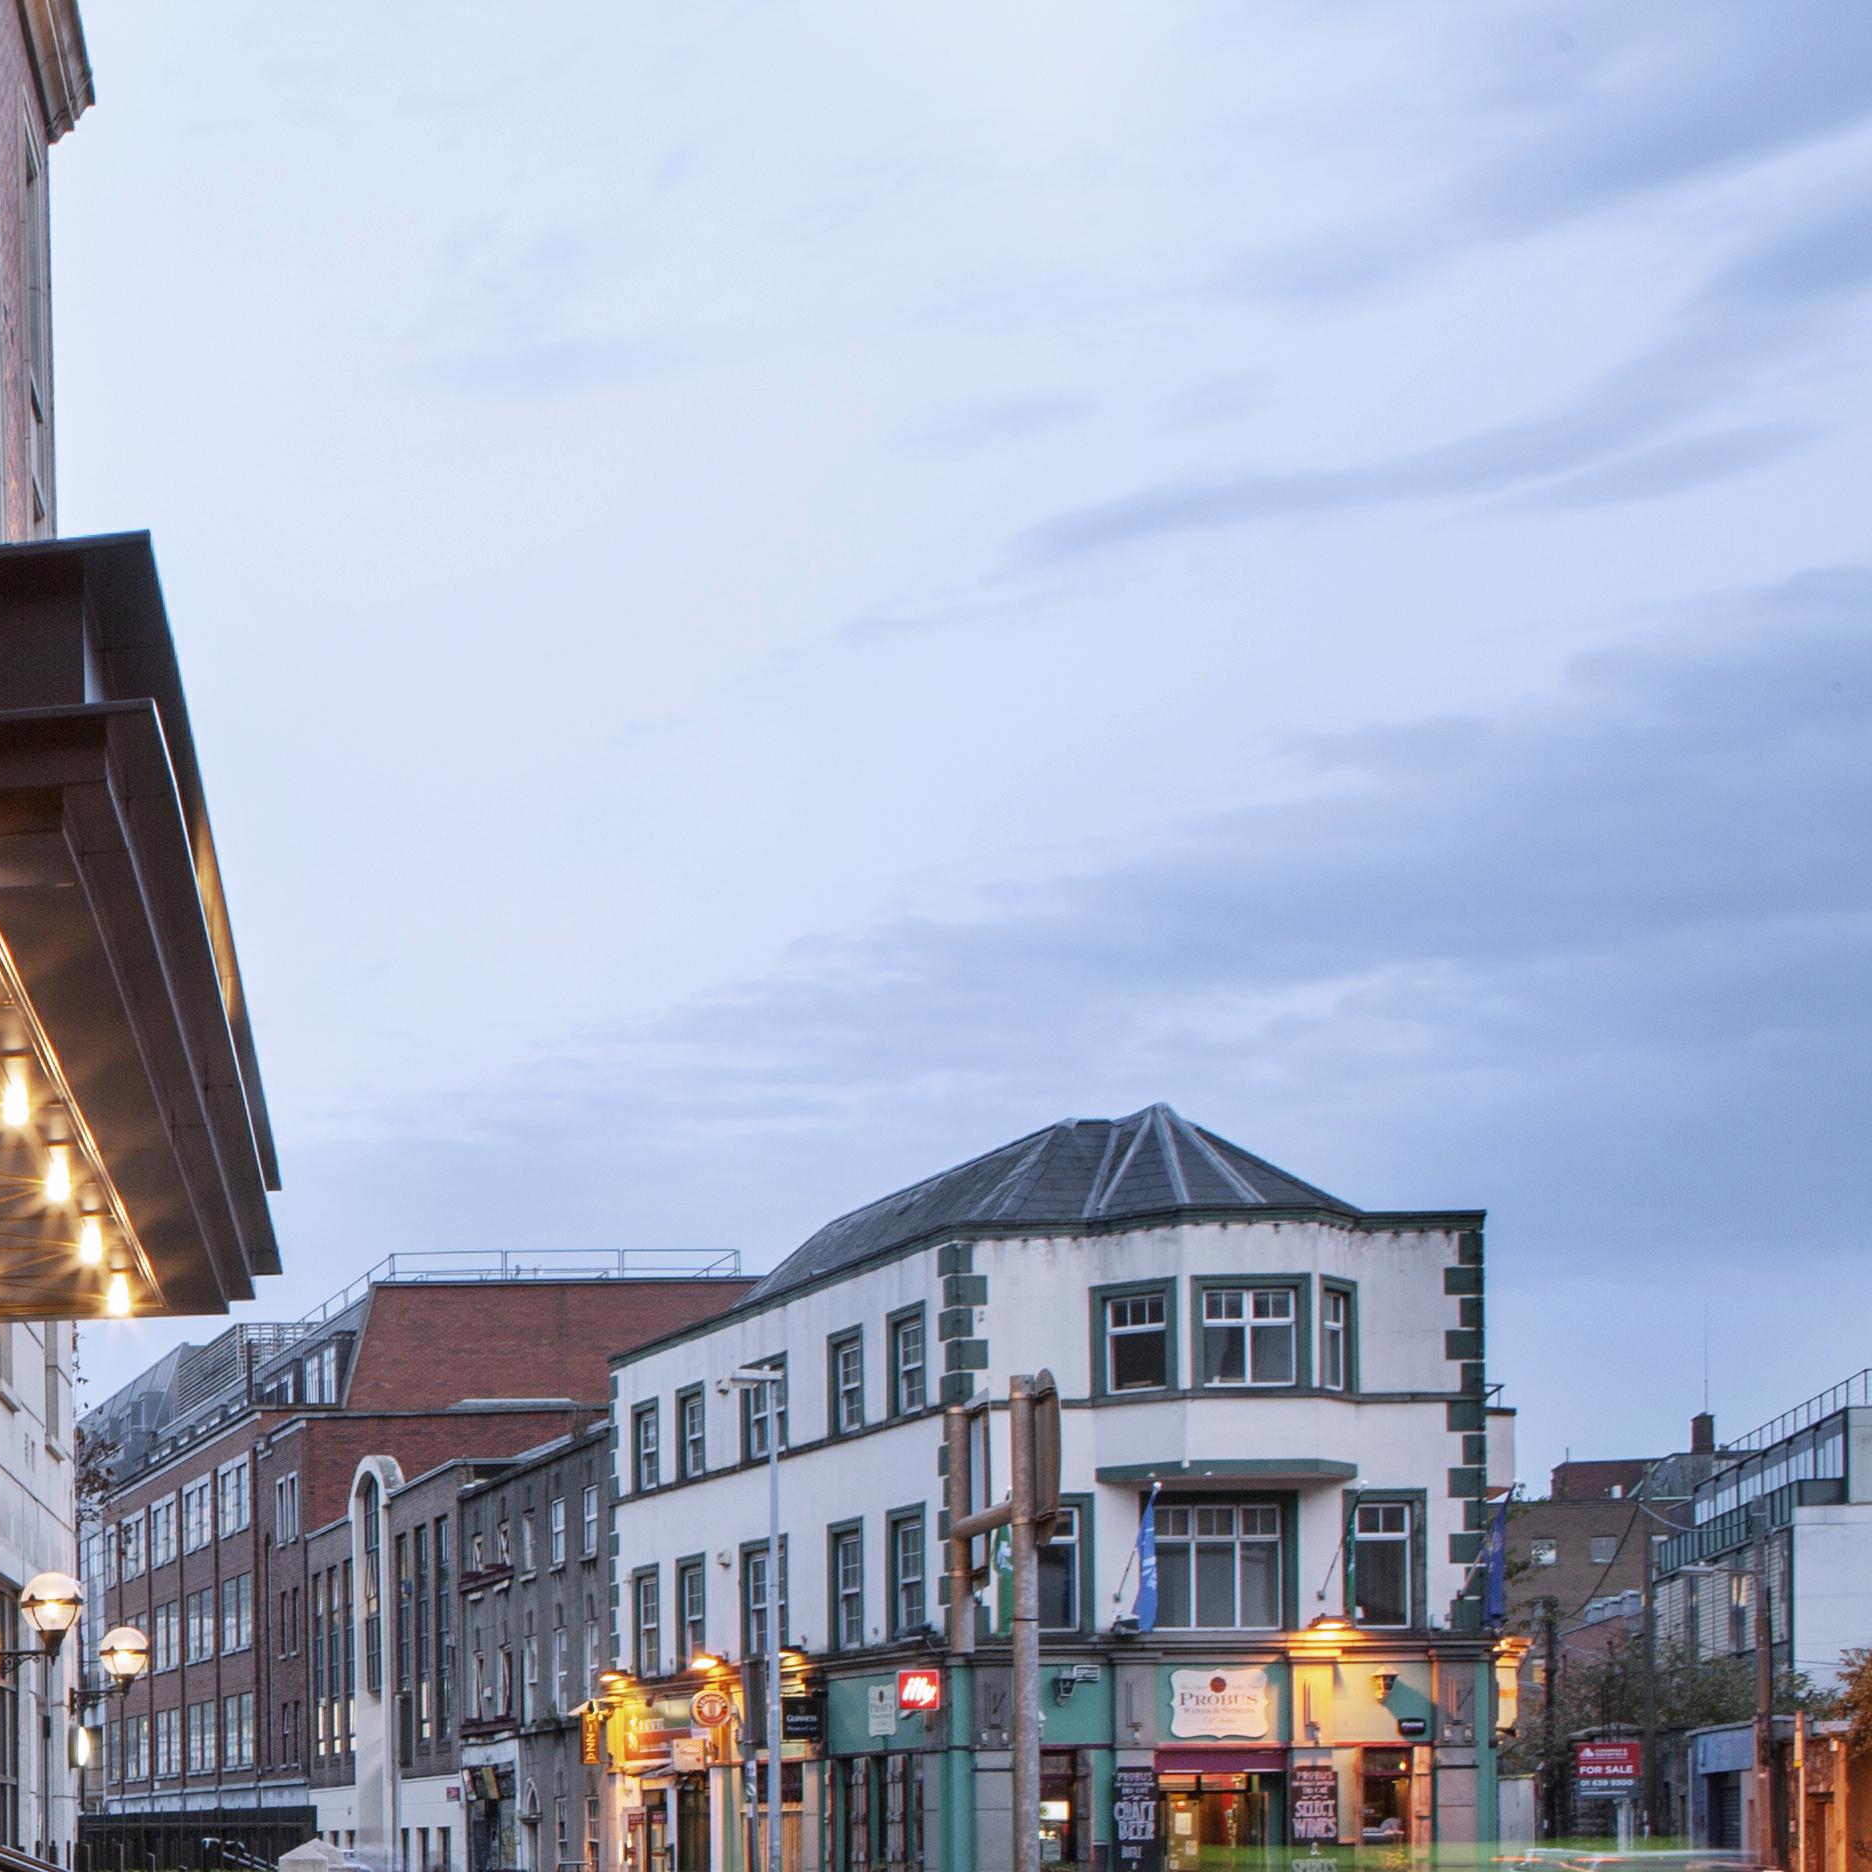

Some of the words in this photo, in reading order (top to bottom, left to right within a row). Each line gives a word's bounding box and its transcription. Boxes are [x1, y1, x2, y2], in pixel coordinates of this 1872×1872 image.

[901, 1676, 937, 1706] illy
[1179, 1692, 1258, 1706] PROBUS
[786, 1714, 817, 1722] GUINNESS
[585, 1714, 597, 1761] PIZZA
[1117, 1772, 1153, 1781] PROBUS
[1296, 1771, 1334, 1780] PROBUS
[1579, 1766, 1602, 1774] FOR
[1605, 1765, 1634, 1774] SALE
[1114, 1801, 1156, 1821] CRAFT
[1295, 1800, 1336, 1817] SELECT
[1118, 1821, 1155, 1840] BEER
[1292, 1817, 1337, 1838] WINES
[1310, 1842, 1321, 1856] &
